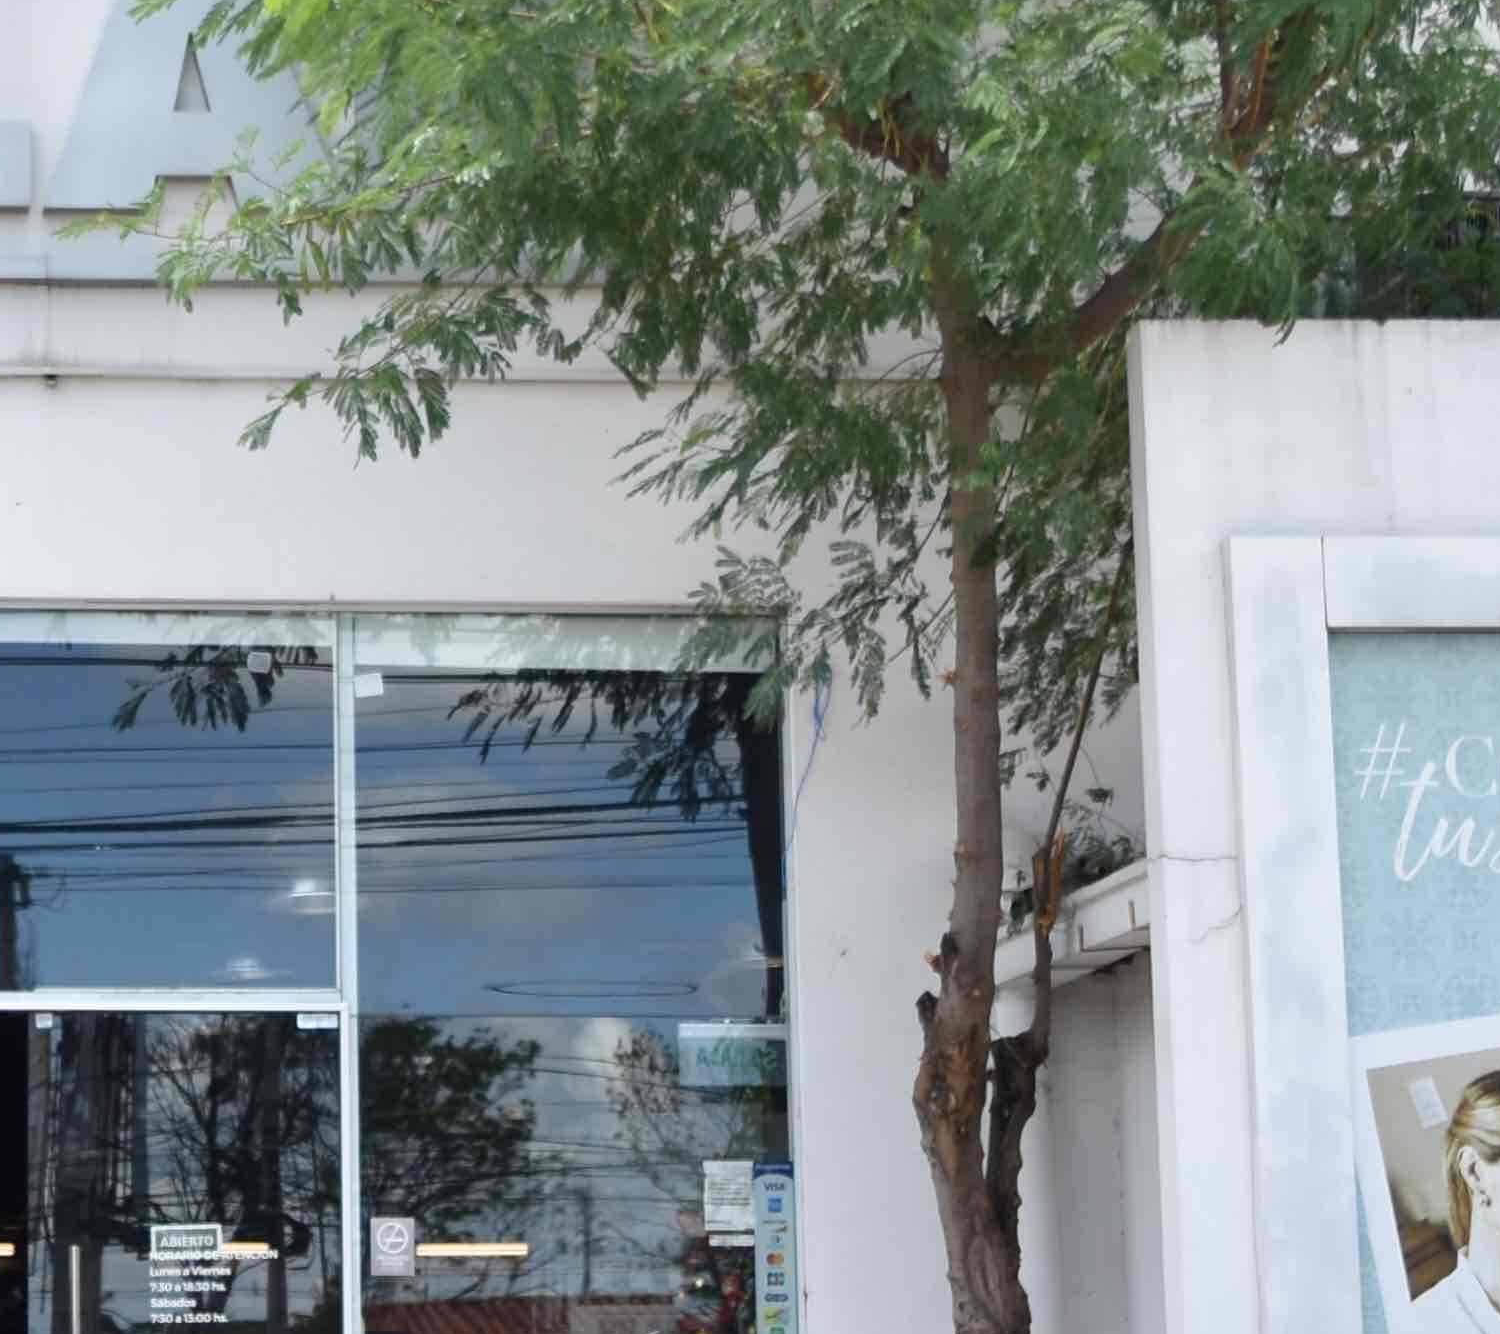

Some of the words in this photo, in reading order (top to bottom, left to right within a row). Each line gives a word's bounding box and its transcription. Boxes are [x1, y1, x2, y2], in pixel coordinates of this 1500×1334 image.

[159, 1234, 214, 1248] ABIERTO
[150, 1267, 182, 1277] Lunes
[191, 1267, 231, 1277] Viernes
